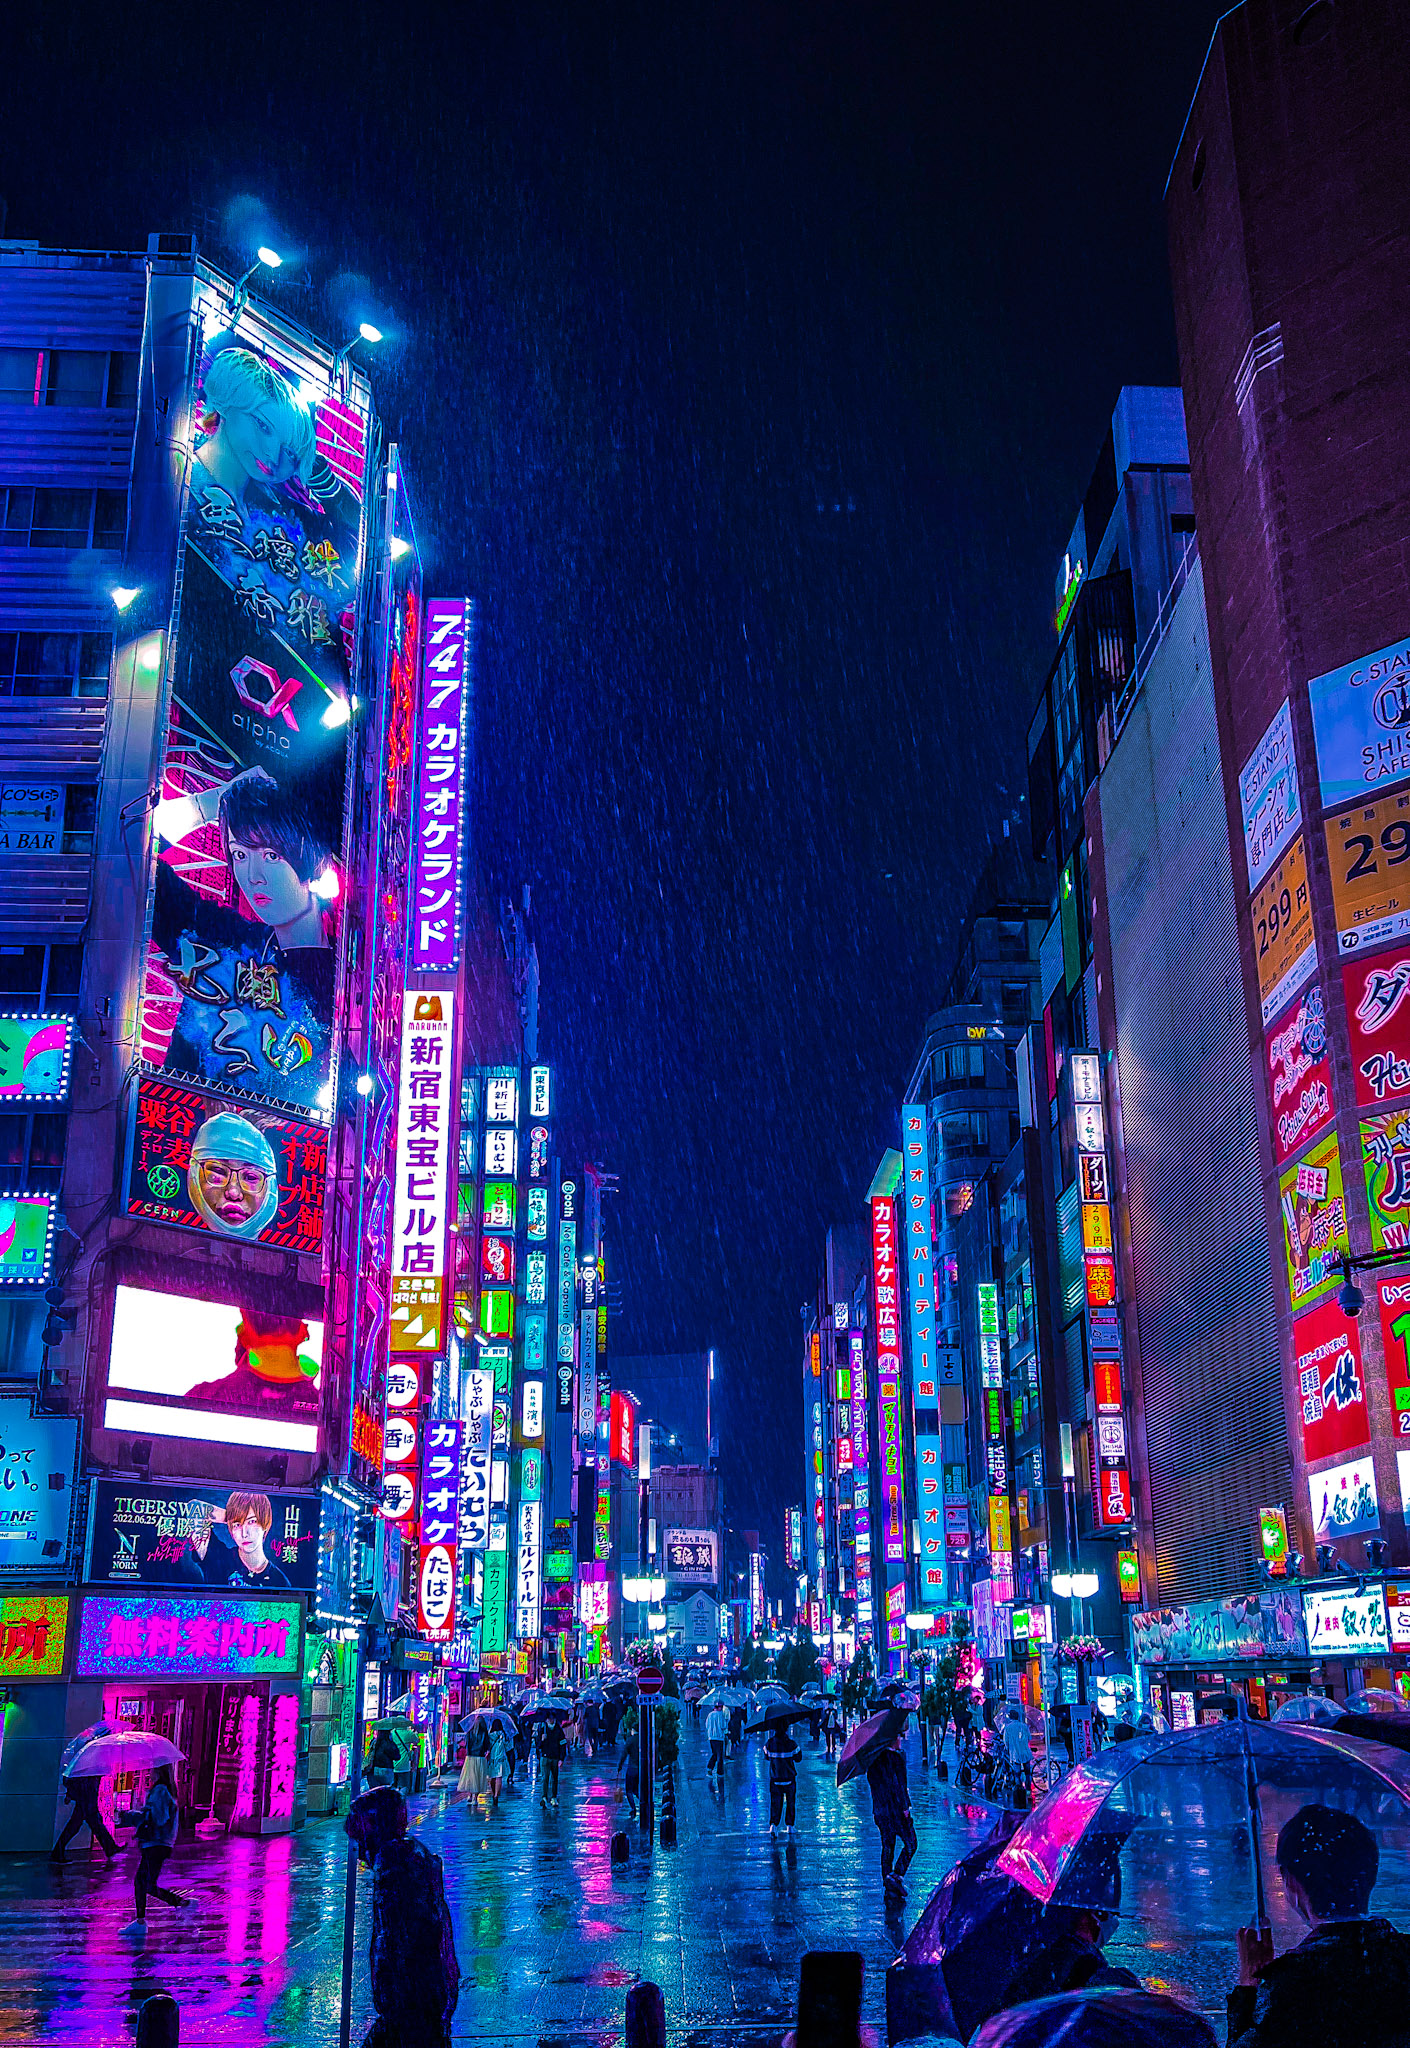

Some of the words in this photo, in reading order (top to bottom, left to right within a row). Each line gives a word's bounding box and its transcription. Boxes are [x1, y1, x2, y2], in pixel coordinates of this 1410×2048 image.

[429, 614, 463, 709] 747
[232, 713, 290, 749] alpha
[1247, 777, 1286, 842] シーシャ
[16, 834, 55, 848] BAR
[419, 723, 458, 951] カラオケランド
[1250, 805, 1284, 867] 専門店
[1257, 881, 1308, 960] 299円
[1353, 899, 1399, 921] 生ビール
[1343, 935, 1358, 947] 7F
[408, 1021, 448, 1031] MARUHAN
[494, 1080, 508, 1120] 川新ビル
[535, 1075, 545, 1112] 東京ビル
[401, 1036, 444, 1273] 新宿東宝ビル店
[493, 1131, 506, 1173] たいむら
[277, 1136, 301, 1230] オープン
[297, 1140, 327, 1239] 新店舗
[1089, 1158, 1103, 1191] ダーツ
[144, 1203, 180, 1219] CERN
[562, 1180, 576, 1218] Booth
[1093, 1206, 1103, 1245] 299円
[1312, 1197, 1346, 1250] 麻雀
[874, 1202, 897, 1347] カラオケ歌広場
[908, 1117, 935, 1396] カラオケ&パーティー館
[582, 1267, 598, 1304] Booth
[1088, 1266, 1112, 1299] 麻雀
[407, 1380, 417, 1390] た
[558, 1366, 573, 1405] Booth
[584, 1372, 593, 1402] カプセル
[1323, 1350, 1360, 1411] 一休
[469, 1373, 484, 1443] しゃぶしゃぶ
[403, 1433, 415, 1444] ば
[995, 1446, 1007, 1488] AGEHA
[1107, 1457, 1119, 1465] 3F
[403, 1490, 411, 1500] こ
[424, 1424, 457, 1544] カラオケ
[890, 1485, 898, 1504] Shop
[113, 1513, 156, 1524] 2022.06.25
[114, 1497, 215, 1519] TIGERSWAR
[285, 1504, 301, 1539] 山田
[921, 1449, 944, 1584] カラオケ館
[1334, 1483, 1376, 1524] 叙々苑
[114, 1528, 140, 1554] N
[155, 1516, 213, 1539] 優勝者
[524, 1506, 534, 1542] 喫茶室
[596, 1527, 608, 1558] CASINO
[890, 1524, 898, 1536] Tax
[112, 1561, 138, 1569] NORN
[521, 1547, 536, 1602] ルノアール
[426, 1555, 450, 1622] たばこ
[488, 1569, 500, 1649] カワノ・クォーク
[1325, 1616, 1339, 1631] 焼肉
[1342, 1599, 1386, 1638] 叙々苑
[103, 1615, 290, 1658] 無料案内所
